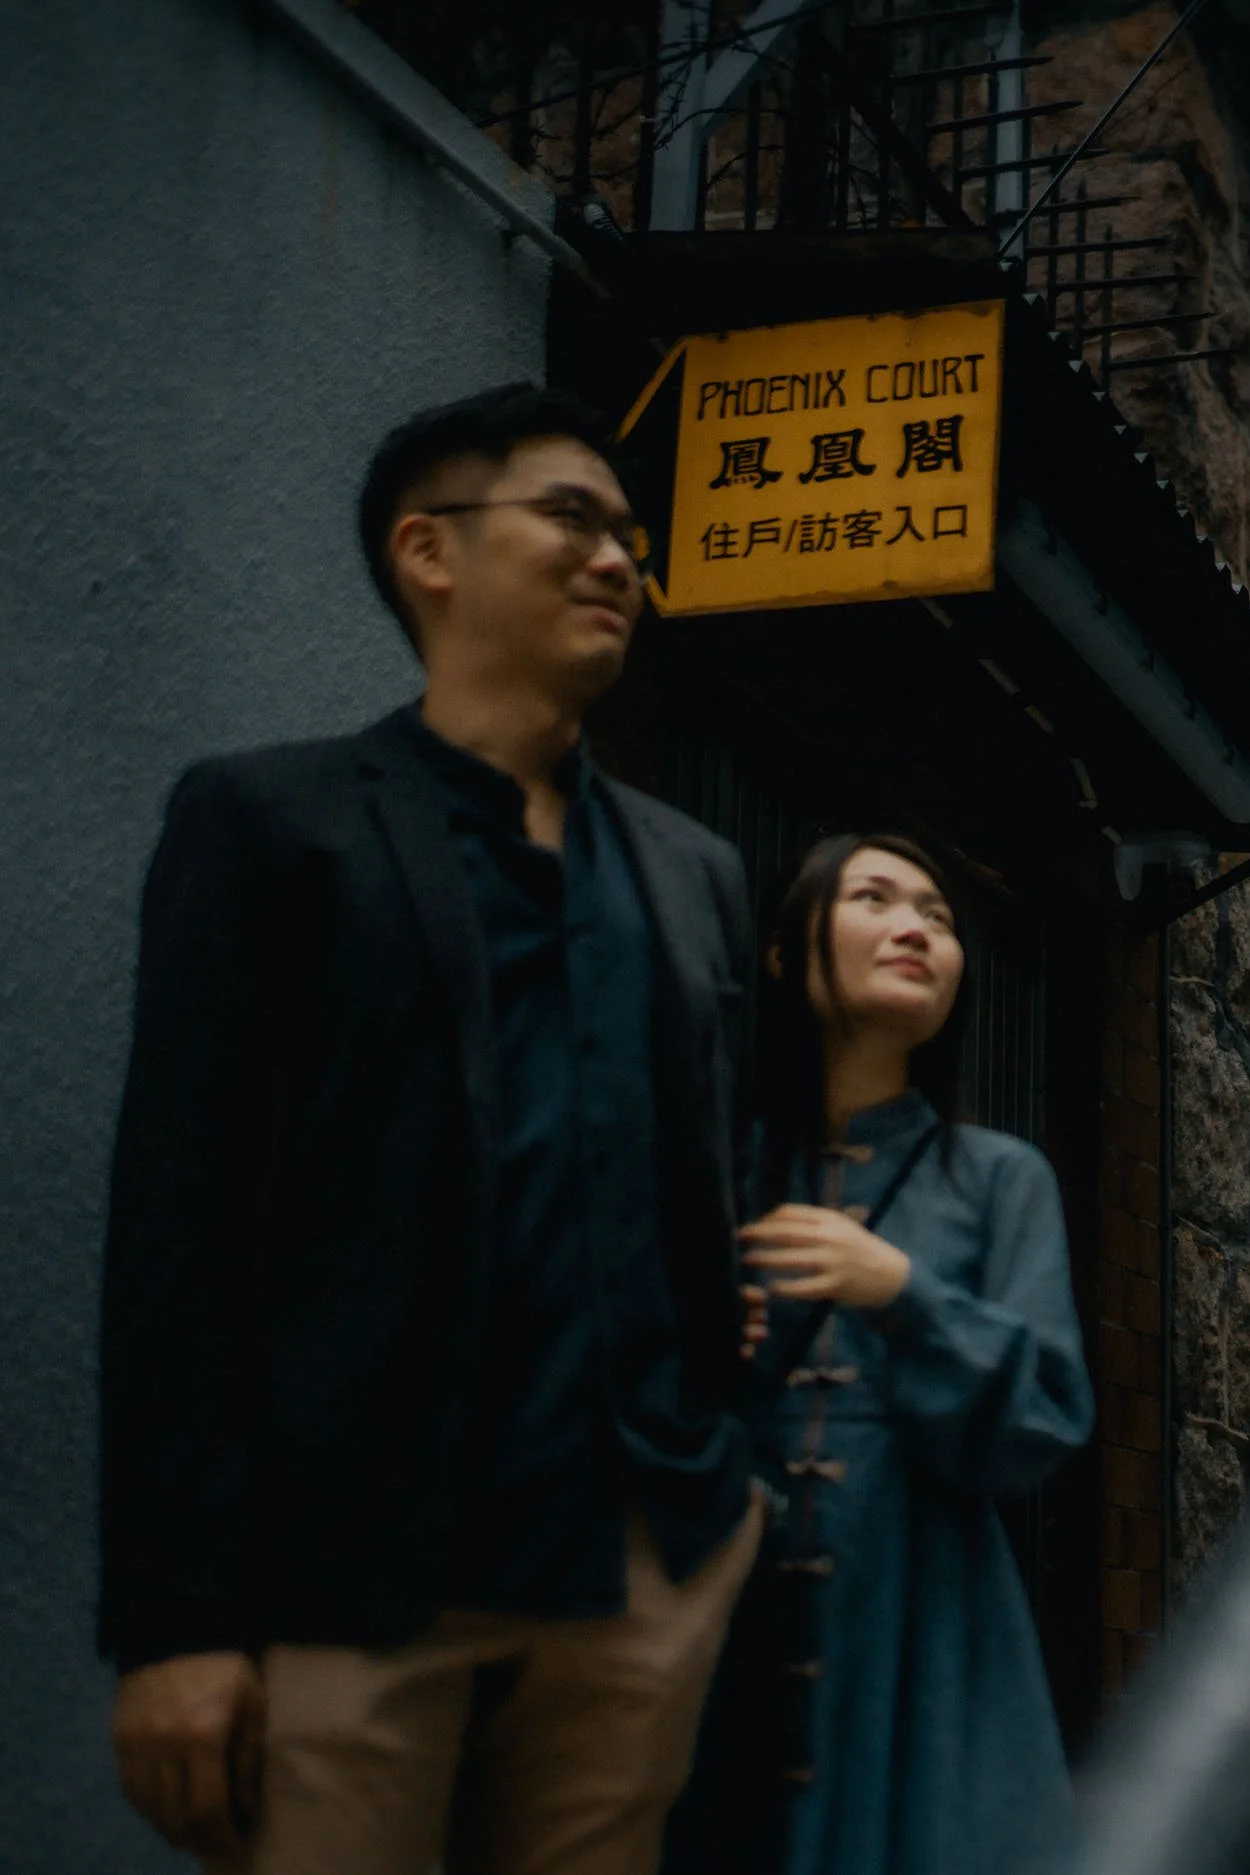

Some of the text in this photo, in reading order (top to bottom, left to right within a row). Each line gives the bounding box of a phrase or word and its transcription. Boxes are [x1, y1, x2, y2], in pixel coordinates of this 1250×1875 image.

[696, 353, 986, 421] PHOENIX COURT
[708, 414, 965, 490] 鳳凰閣
